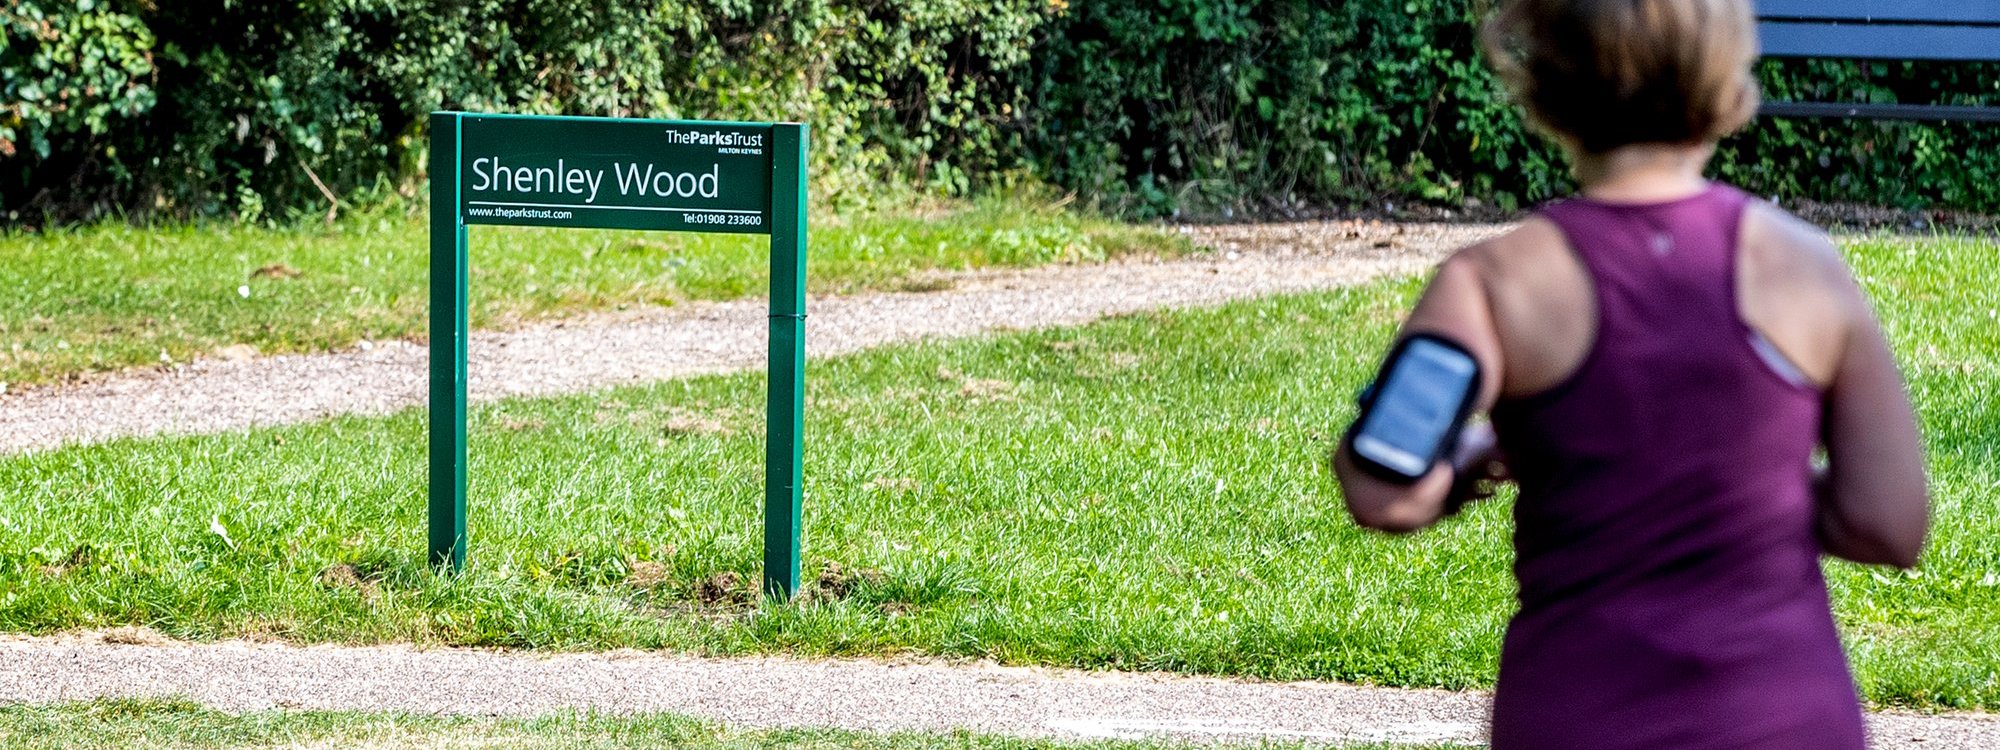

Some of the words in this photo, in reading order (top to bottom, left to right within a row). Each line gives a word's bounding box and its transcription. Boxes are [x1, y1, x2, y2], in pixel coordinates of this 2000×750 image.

[666, 130, 762, 147] TheParksTrust
[472, 156, 604, 203] Shenley
[614, 162, 719, 198] Wood
[468, 207, 572, 220] www.theparkstrust.com
[683, 213, 726, 225] Tel:01908
[727, 214, 762, 226] 233600
